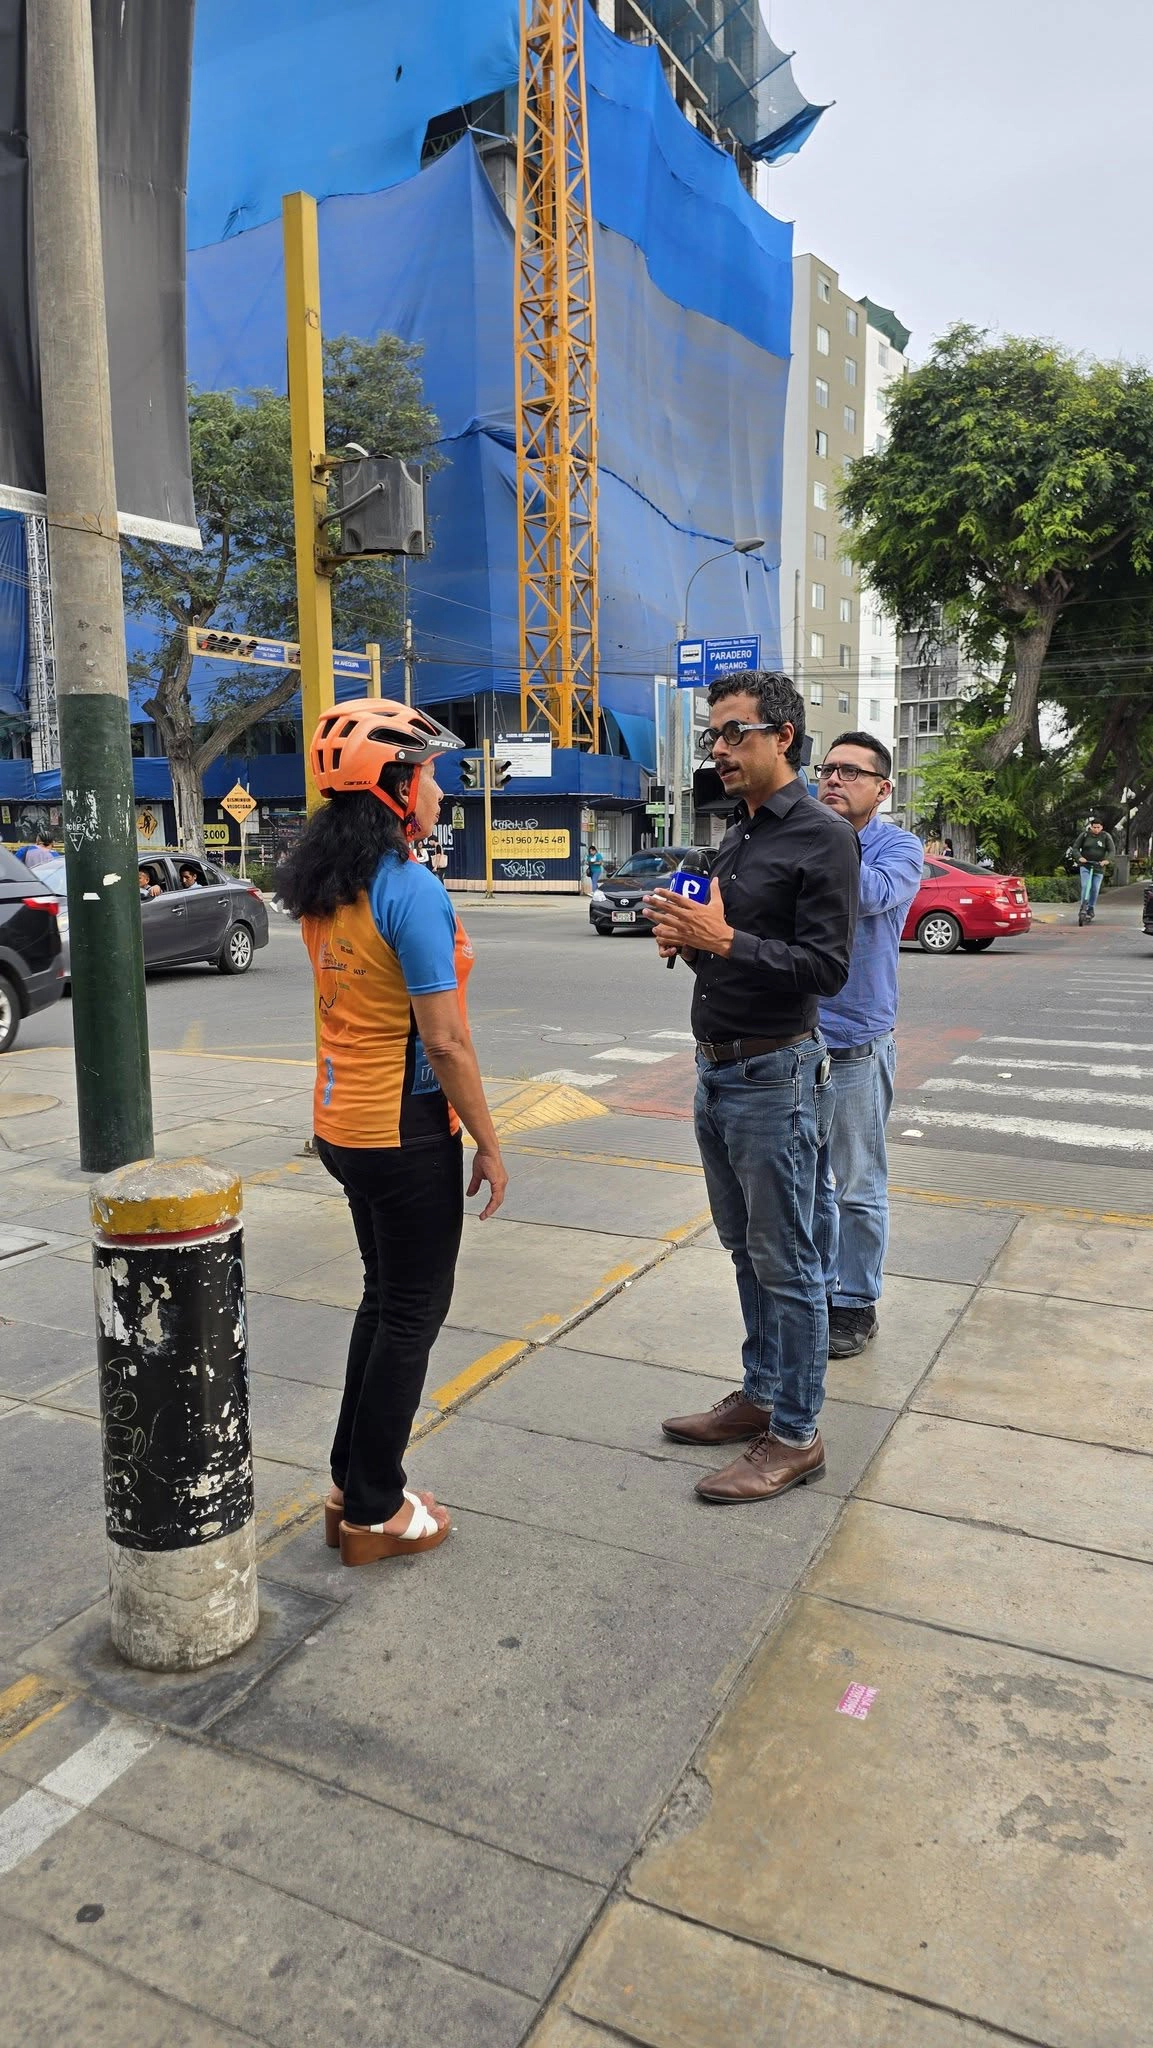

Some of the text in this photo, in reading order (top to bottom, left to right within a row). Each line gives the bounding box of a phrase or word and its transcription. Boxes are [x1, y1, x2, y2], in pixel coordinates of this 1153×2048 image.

[710, 650, 752, 660] PARADERO
[714, 661, 748, 671] ANGAMOS
[501, 836, 566, 844] +51 960 745 481
